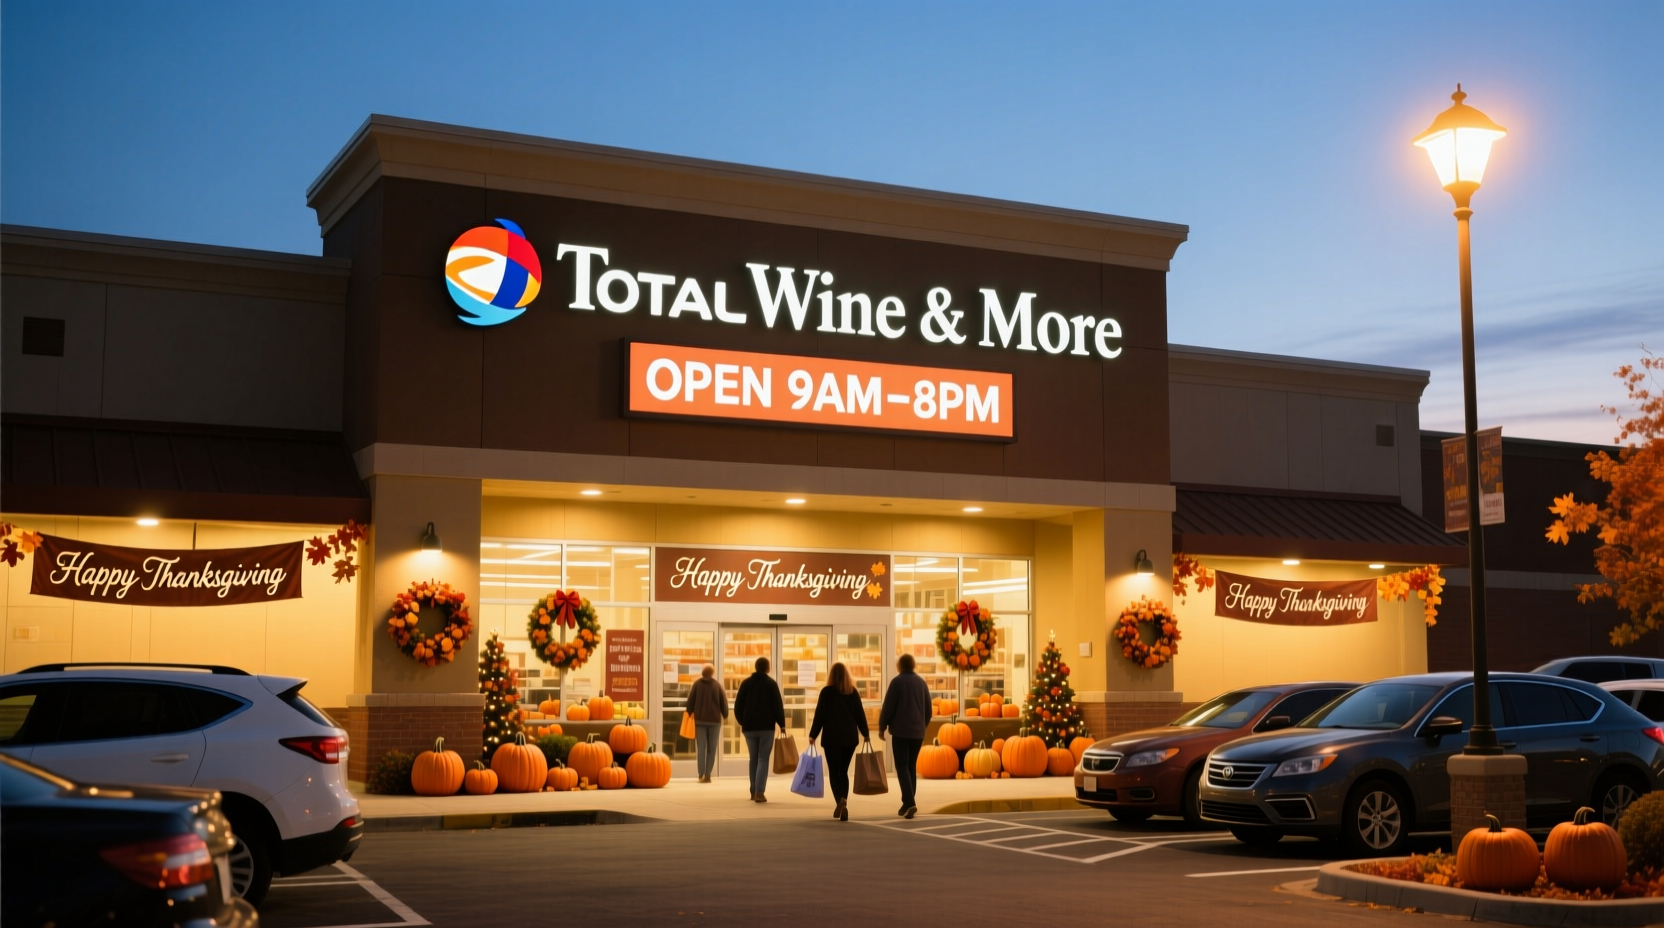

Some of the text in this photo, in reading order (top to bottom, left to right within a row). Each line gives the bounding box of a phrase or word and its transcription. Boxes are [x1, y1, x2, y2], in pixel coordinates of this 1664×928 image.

[745, 262, 906, 339] Wine
[920, 287, 967, 345] &
[978, 288, 1122, 359] More
[645, 357, 773, 408] OPEN
[50, 551, 287, 599] Happy Thanksgiving
[670, 556, 870, 600] Happy Thanksgiving
[1225, 582, 1370, 620] Happy Thanksgiving
